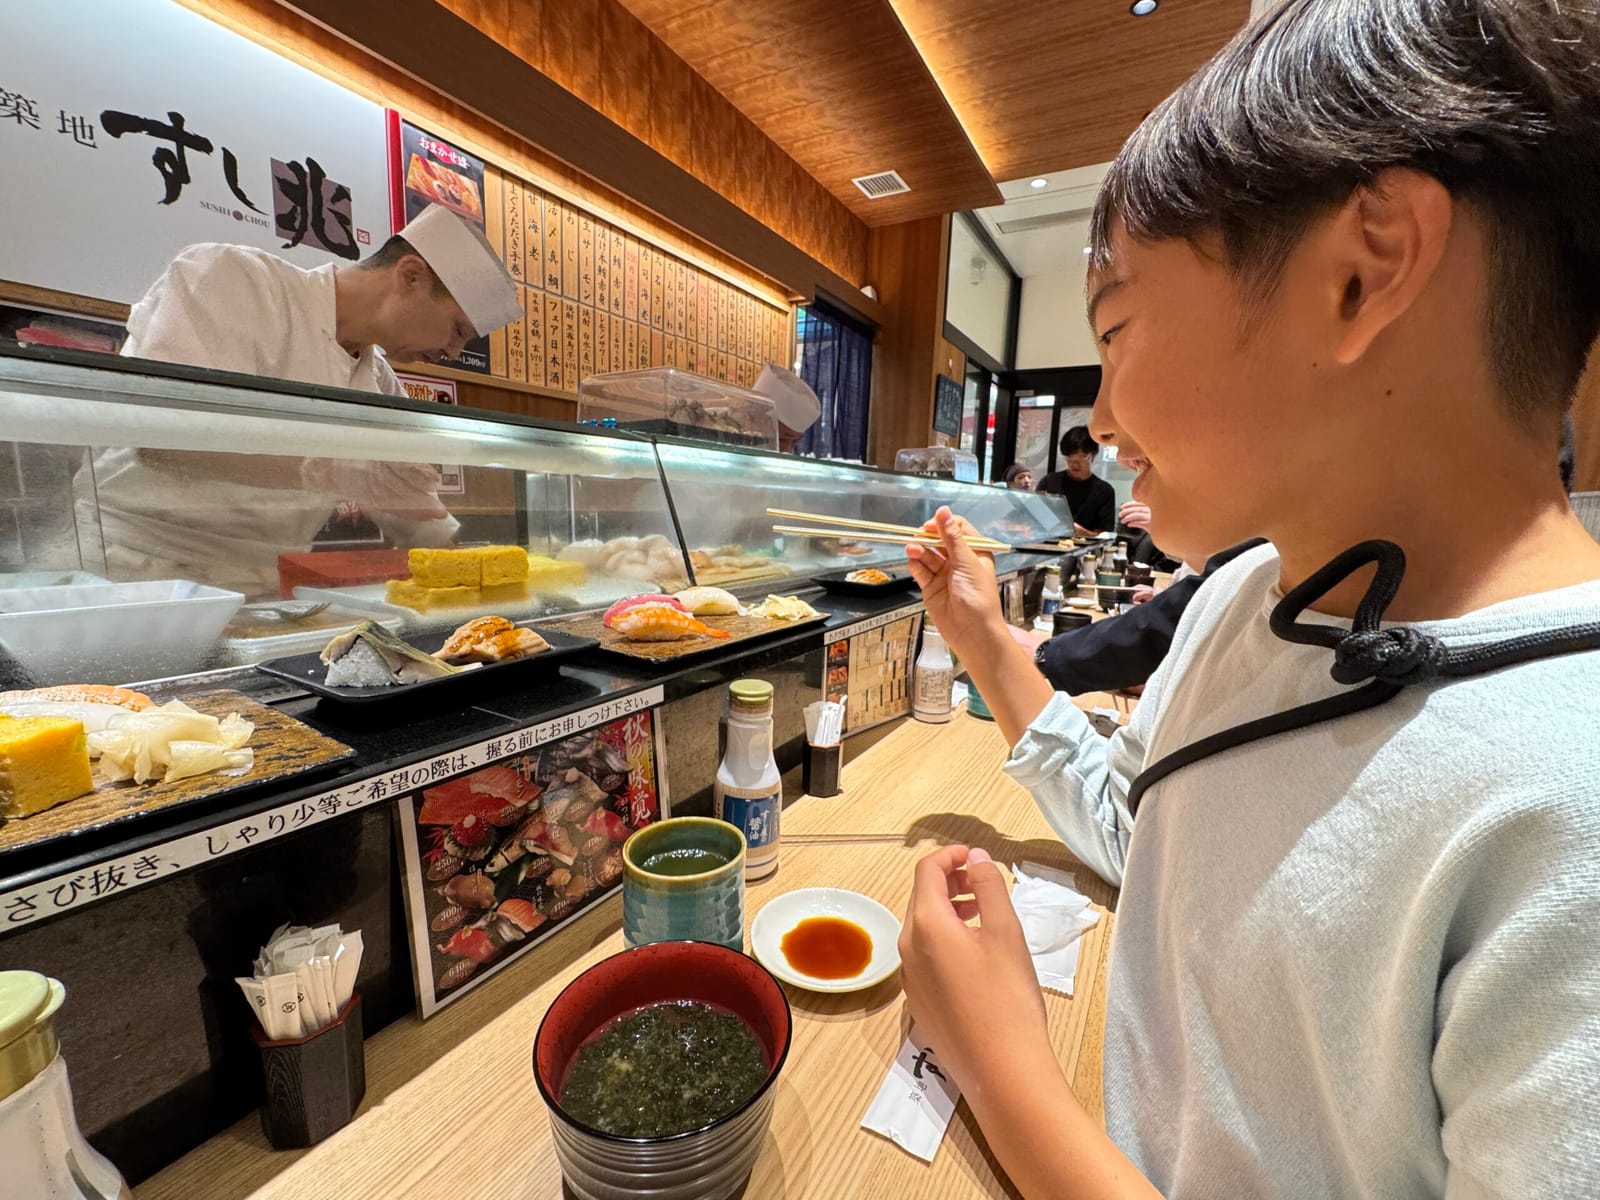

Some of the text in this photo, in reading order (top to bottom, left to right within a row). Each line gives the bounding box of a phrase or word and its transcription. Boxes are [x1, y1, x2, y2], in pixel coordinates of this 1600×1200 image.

[200, 201, 271, 228] SUSHI CHOU
[549, 301, 560, 385] フェア日本酒
[622, 714, 653, 825] 秋の味覚
